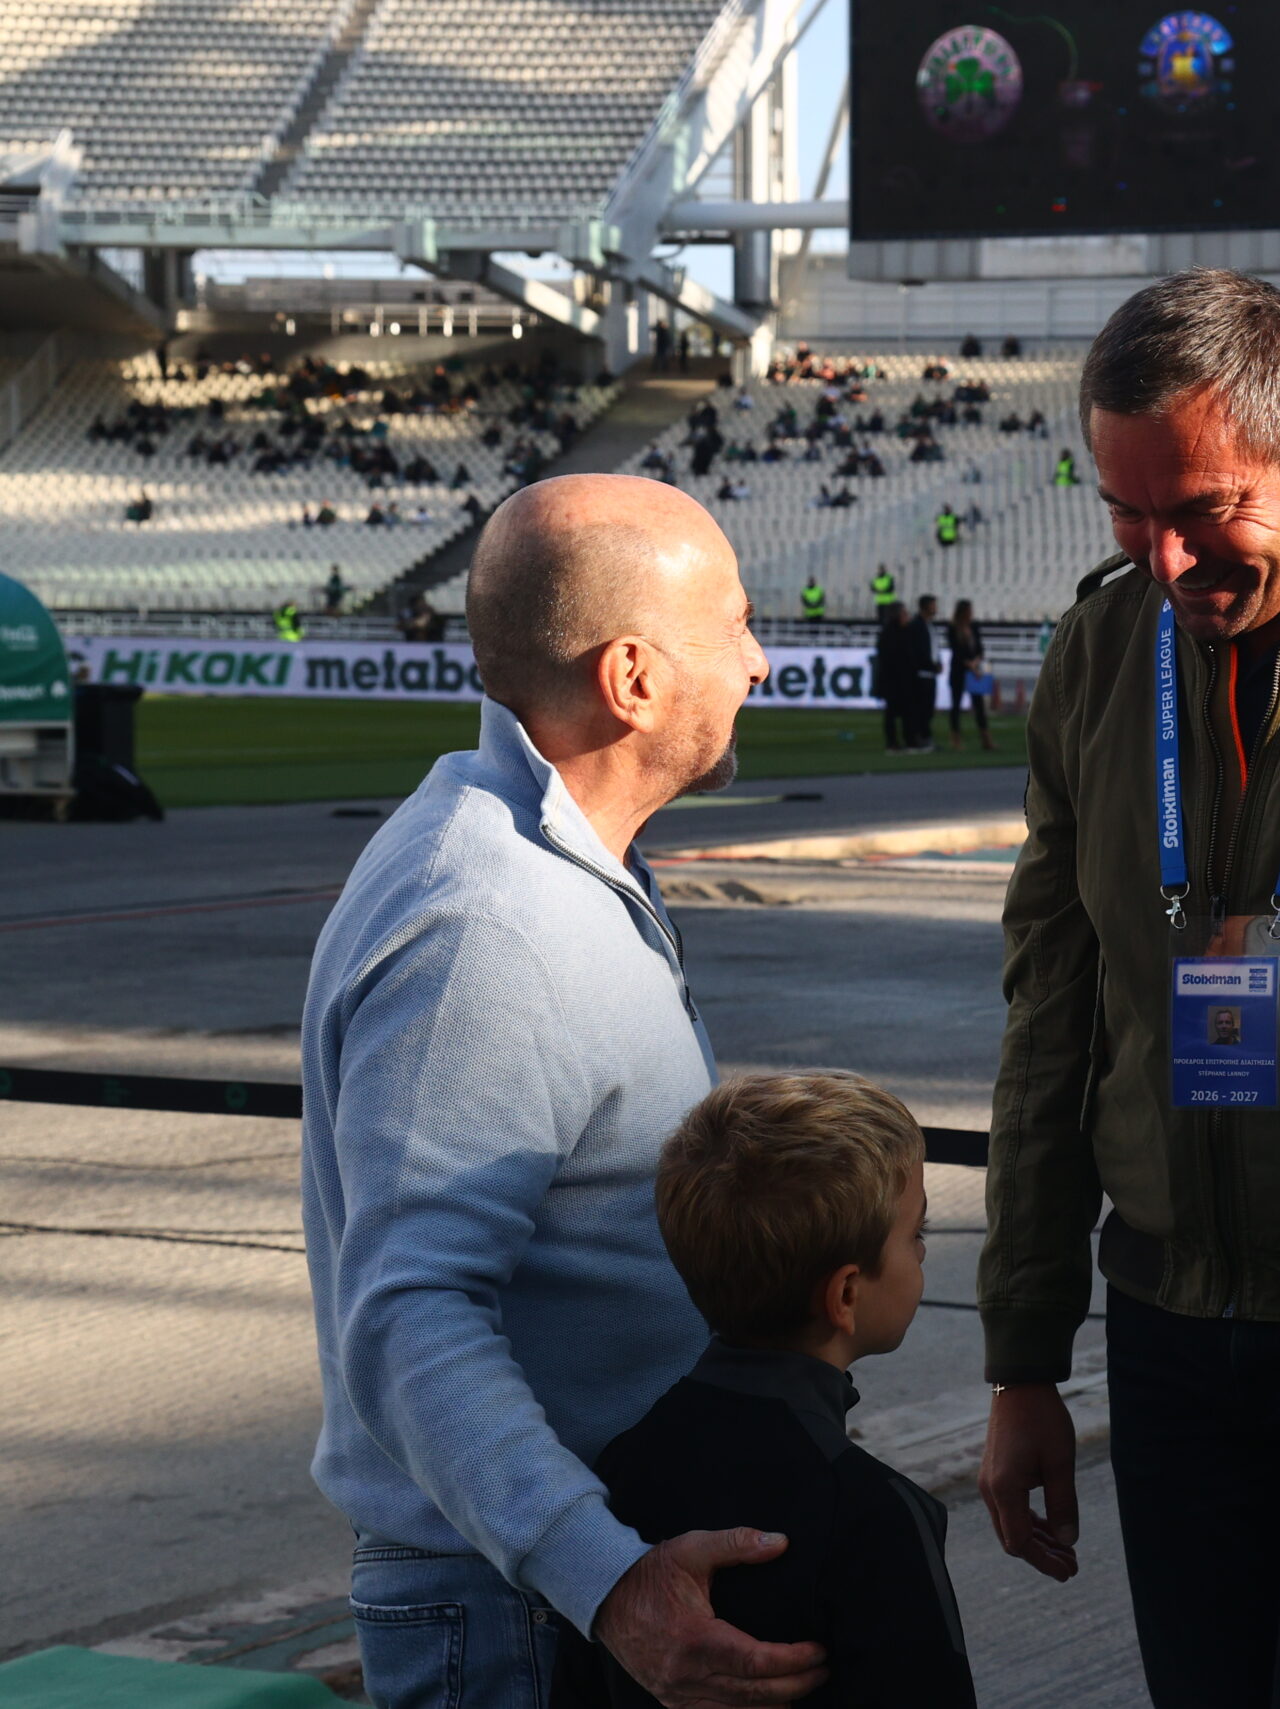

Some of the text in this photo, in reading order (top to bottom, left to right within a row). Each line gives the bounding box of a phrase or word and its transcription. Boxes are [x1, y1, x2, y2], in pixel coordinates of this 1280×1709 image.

[101, 650, 292, 687] HiKOKI
[1160, 627, 1173, 687] LEAGUE
[1161, 690, 1174, 740] SUPER
[1162, 757, 1179, 849] Stoiximan
[1181, 973, 1242, 985] Stoiximan
[1190, 1090, 1219, 1101] 2026
[1229, 1091, 1259, 1102] 2027
